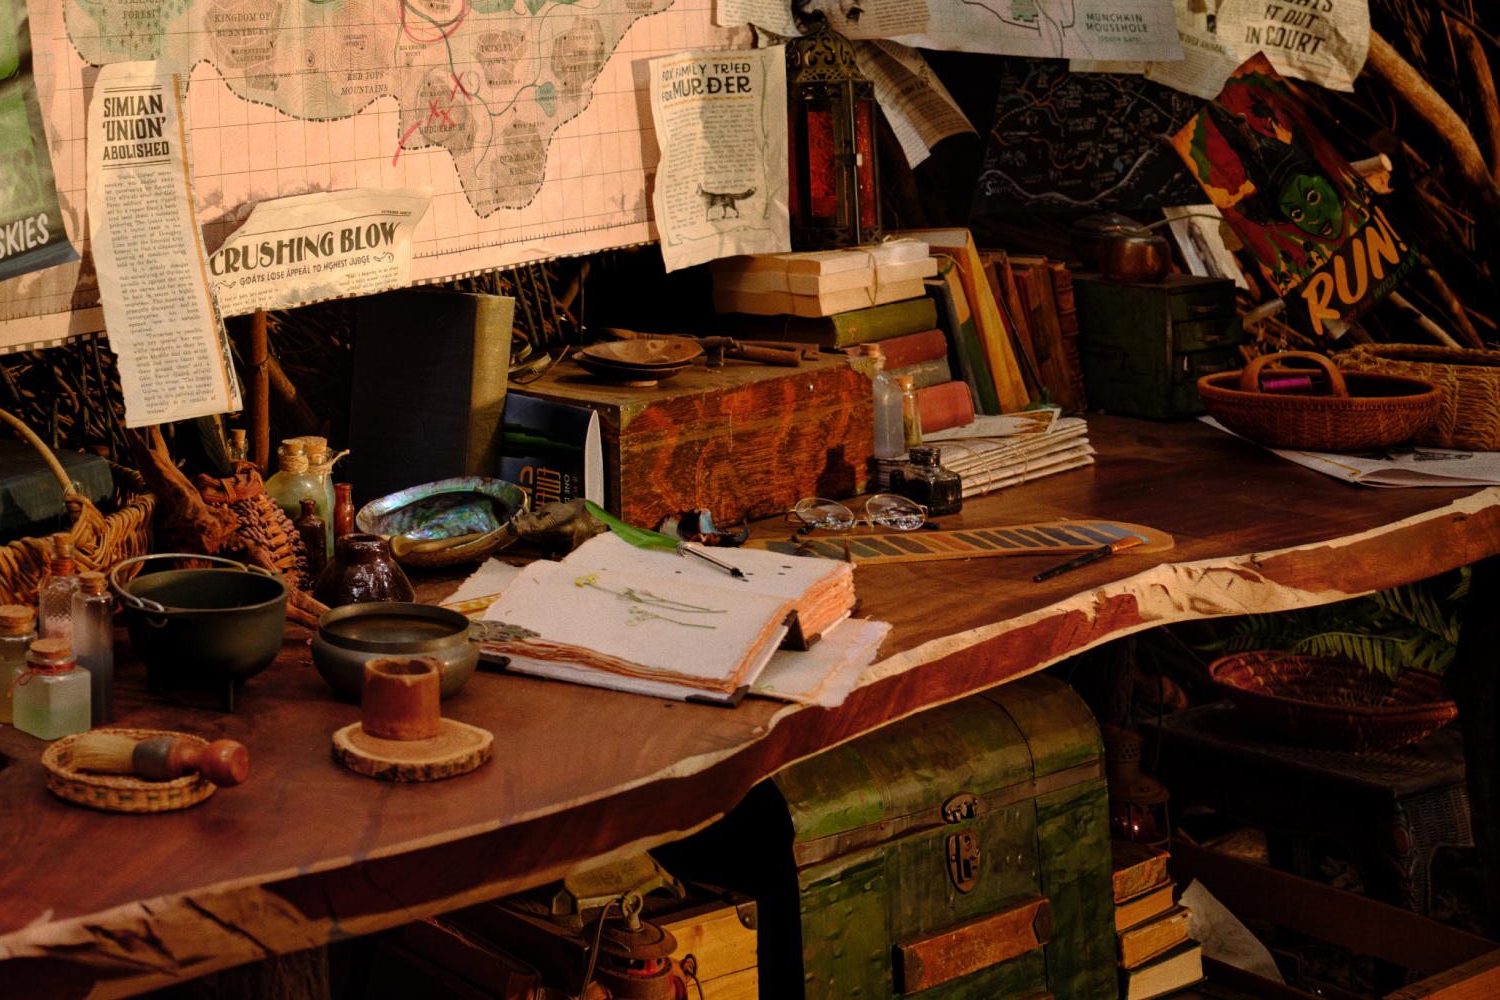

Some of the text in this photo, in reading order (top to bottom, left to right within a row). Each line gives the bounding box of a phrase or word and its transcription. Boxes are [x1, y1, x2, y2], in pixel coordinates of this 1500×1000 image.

[122, 10, 157, 20] FOREST
[214, 13, 257, 23] KINGDOM
[1086, 12, 1144, 23] MUNCHKIN
[1263, 4, 1319, 30] IT OUT
[1085, 22, 1149, 33] MOUSEHOLE
[1245, 25, 1326, 55] IN COURT
[661, 62, 752, 83] FOX FAMILY TRIED
[340, 84, 389, 96] MOUNTAINS
[672, 75, 752, 99] MURDER
[103, 93, 164, 119] SIMIAN
[102, 140, 170, 162] ABOLISHED
[209, 221, 402, 277] CRUSHING BLOW
[239, 273, 266, 288] GOATS
[267, 270, 285, 281] LOSE
[286, 266, 311, 279] APPEAL
[312, 264, 322, 274] TO
[349, 254, 371, 266] JUDGE
[1300, 204, 1408, 336] RUN!
